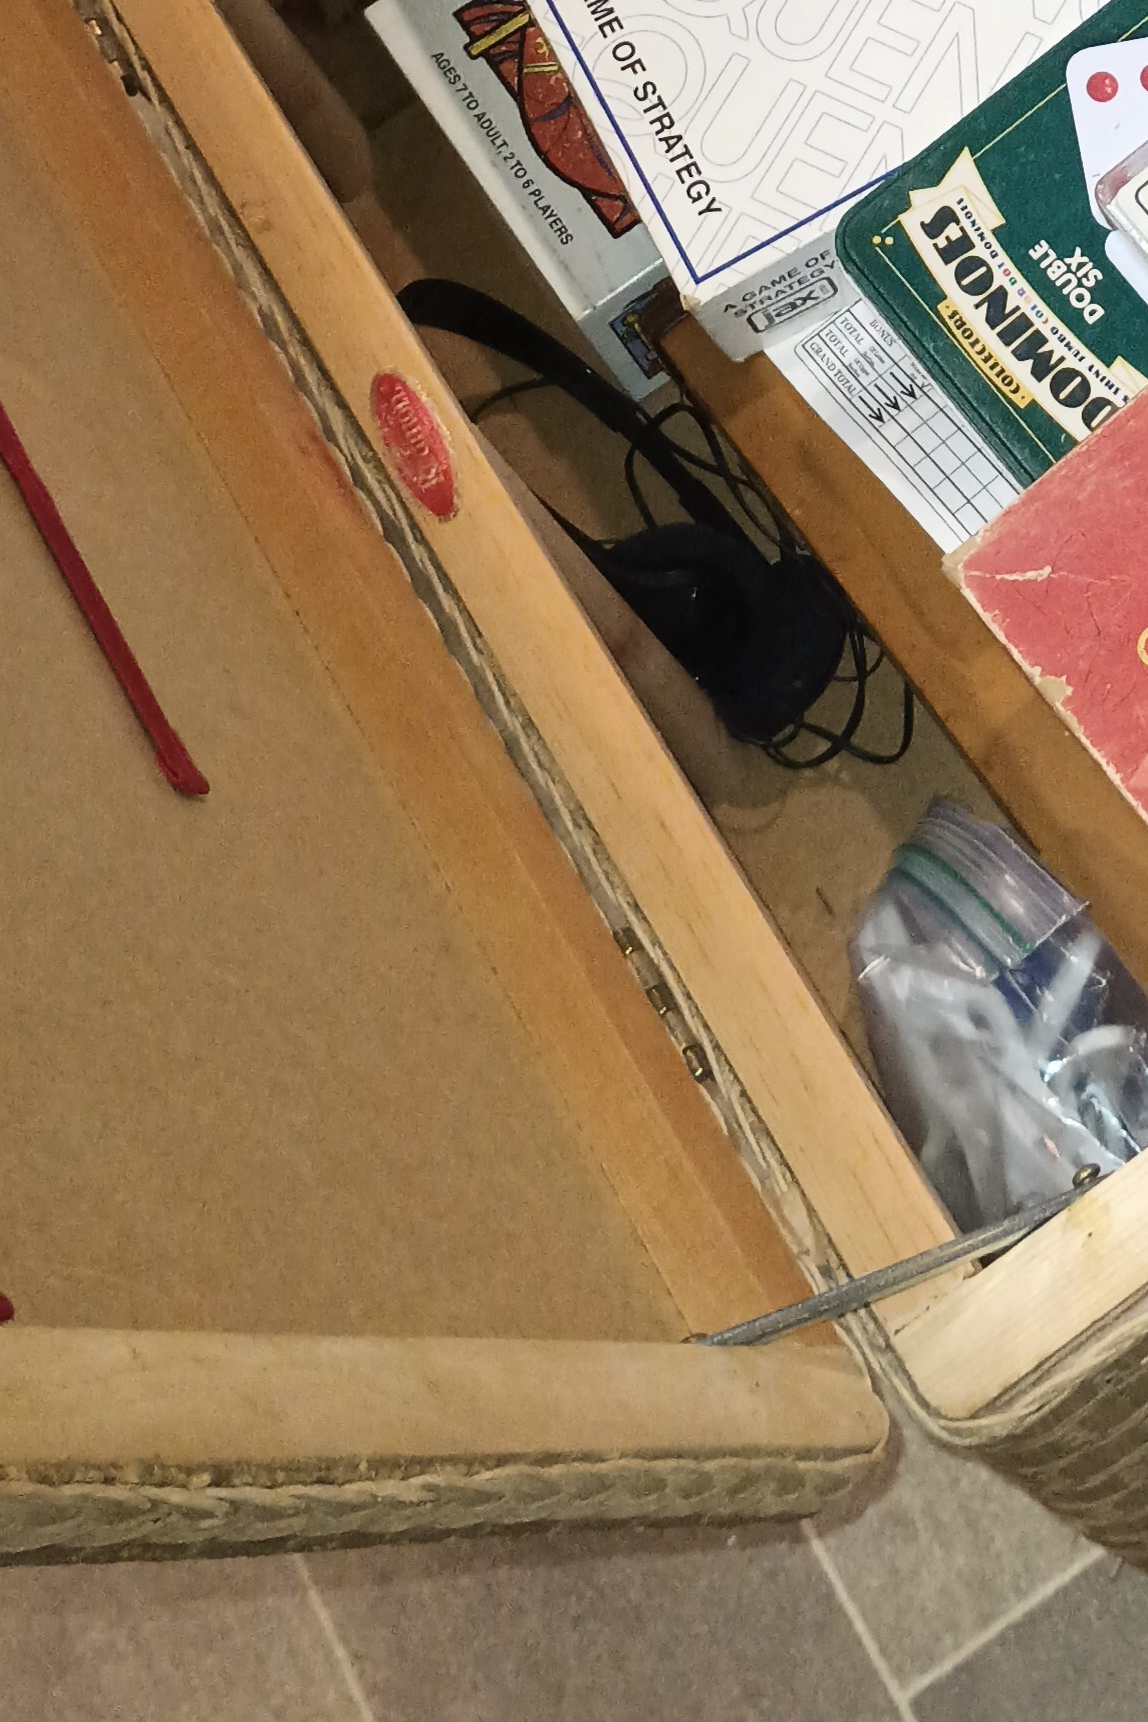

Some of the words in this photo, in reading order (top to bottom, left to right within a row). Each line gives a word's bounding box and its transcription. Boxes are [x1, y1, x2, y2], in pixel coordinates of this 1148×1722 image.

[430, 51, 462, 86] AGES
[455, 83, 468, 93] 7
[461, 91, 480, 111] TO
[473, 111, 509, 156] ADULT,
[611, 40, 648, 76] OF
[632, 80, 725, 218] STRATEGY
[503, 151, 516, 163] 2
[508, 159, 528, 179] TO
[521, 178, 535, 189] 6
[528, 187, 574, 246] PLAYERS
[956, 197, 1000, 260] DOMINOES
[723, 303, 737, 314] A
[741, 267, 800, 302] GAME
[805, 249, 831, 269] OF
[997, 261, 1018, 286] DOT
[1027, 239, 1106, 325] DOUBLE
[1063, 246, 1104, 288] SIX
[734, 260, 836, 318] STRATEGY
[1016, 287, 1049, 325] COLOR
[839, 316, 864, 346] TOTAL
[920, 205, 1121, 432] DOMINOES
[824, 329, 849, 358] TOTAL
[947, 309, 1021, 395] COLLECTORS
[1050, 325, 1086, 363] JUMBO
[809, 342, 836, 375] GRAND
[836, 370, 857, 396] TOTAL
[1087, 364, 1122, 396] SHINY
